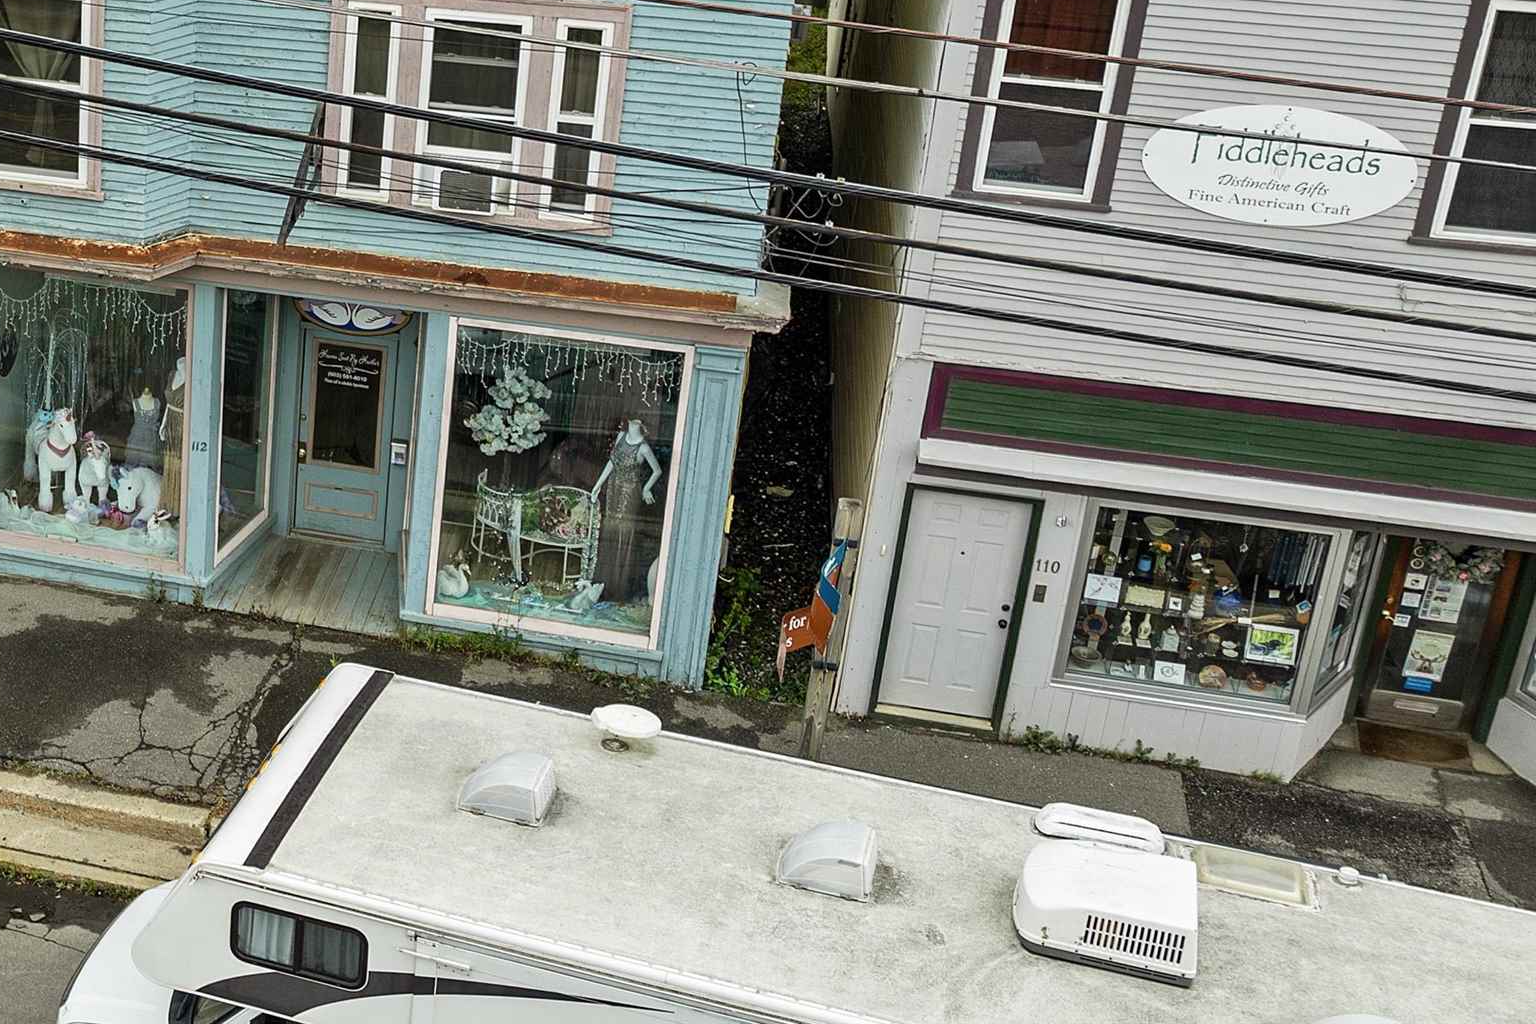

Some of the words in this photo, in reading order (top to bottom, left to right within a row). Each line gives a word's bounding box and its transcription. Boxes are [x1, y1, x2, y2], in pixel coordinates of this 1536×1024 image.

[1217, 174, 1291, 193] Distinctive
[1294, 181, 1330, 199] Gifts
[1187, 188, 1224, 204] Fine
[1228, 193, 1305, 212] American
[1311, 201, 1351, 217] Craft
[191, 440, 208, 452] 112
[1035, 558, 1061, 574] 110
[788, 615, 807, 631] for
